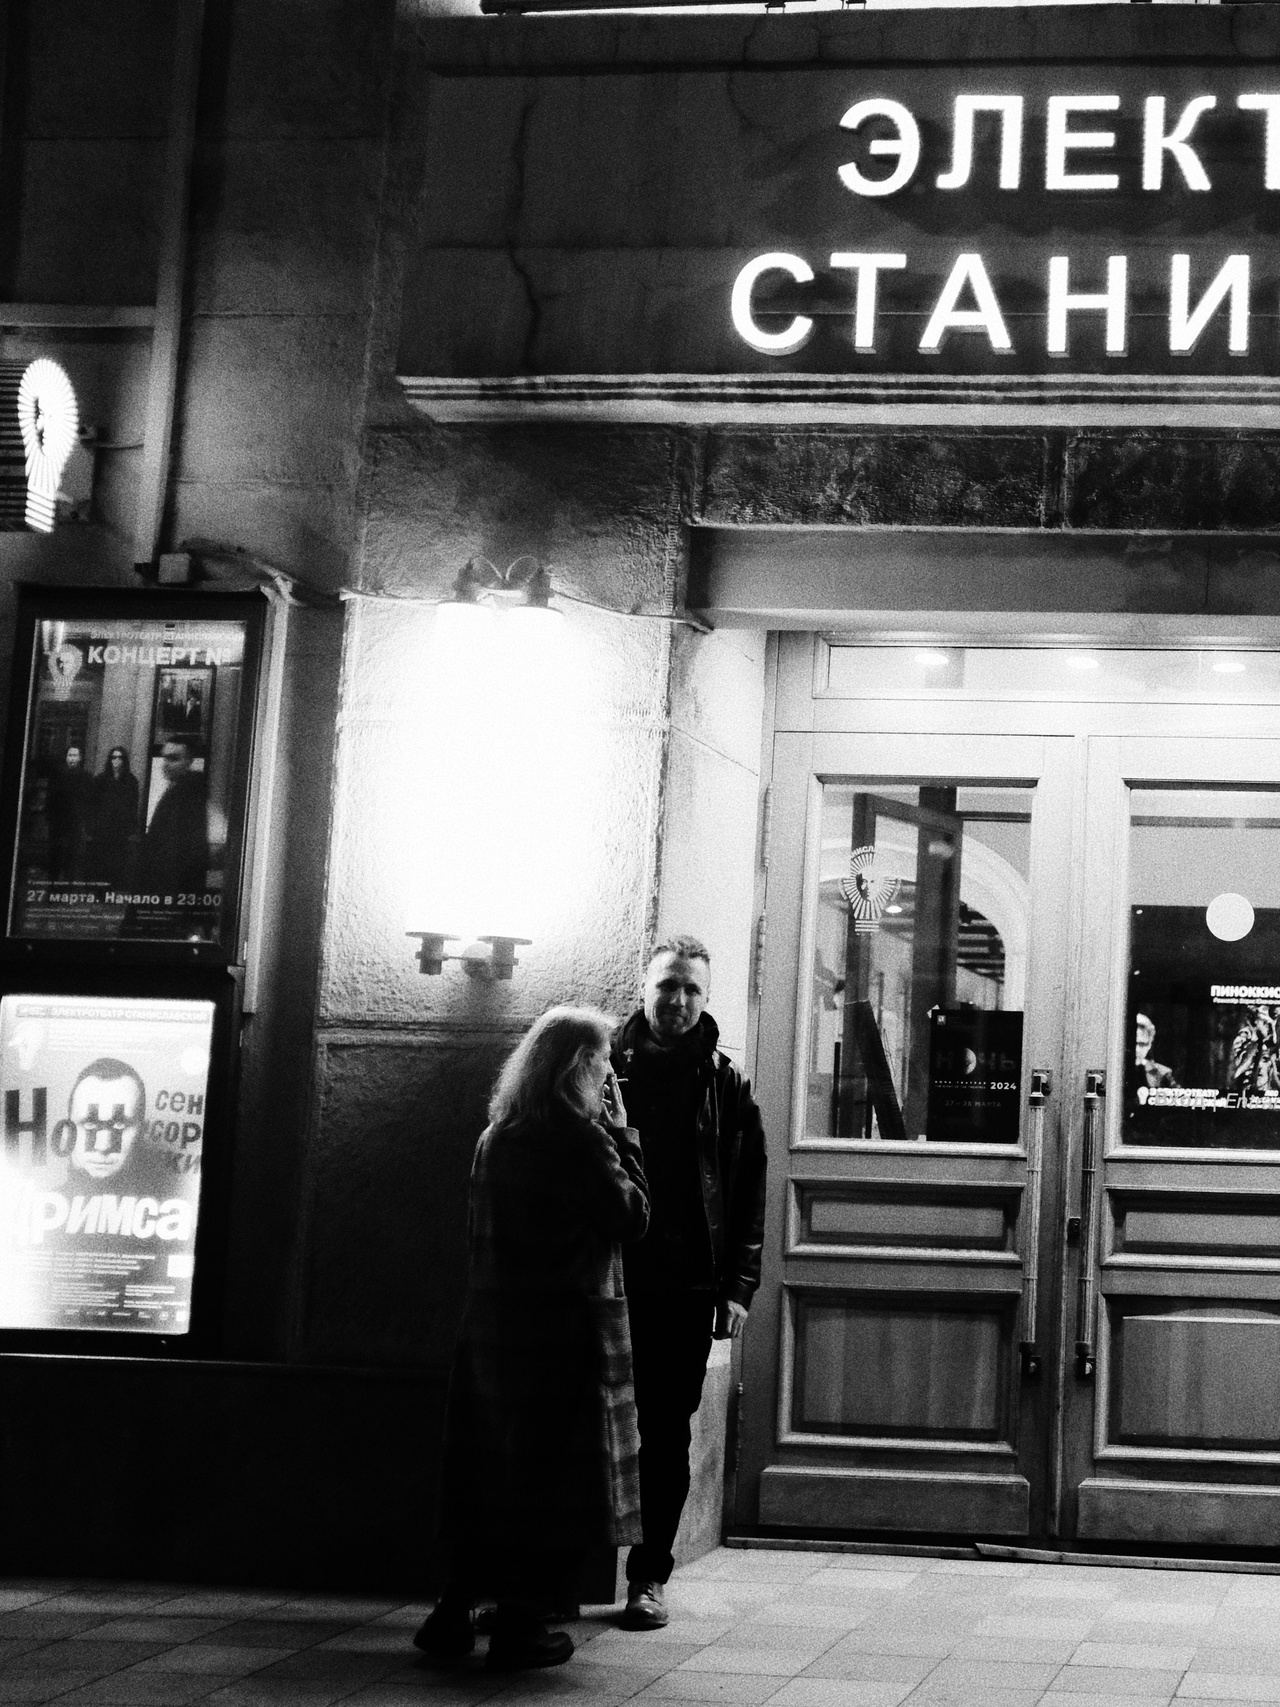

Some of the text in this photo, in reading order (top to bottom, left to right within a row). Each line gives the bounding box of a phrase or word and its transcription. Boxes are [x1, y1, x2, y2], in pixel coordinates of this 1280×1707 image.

[88, 646, 200, 668] КОНЦЕРТ
[27, 890, 221, 906] 27 марта. Начало в 23:00
[990, 1081, 1018, 1090] 2024
[6, 1186, 190, 1245] римса
